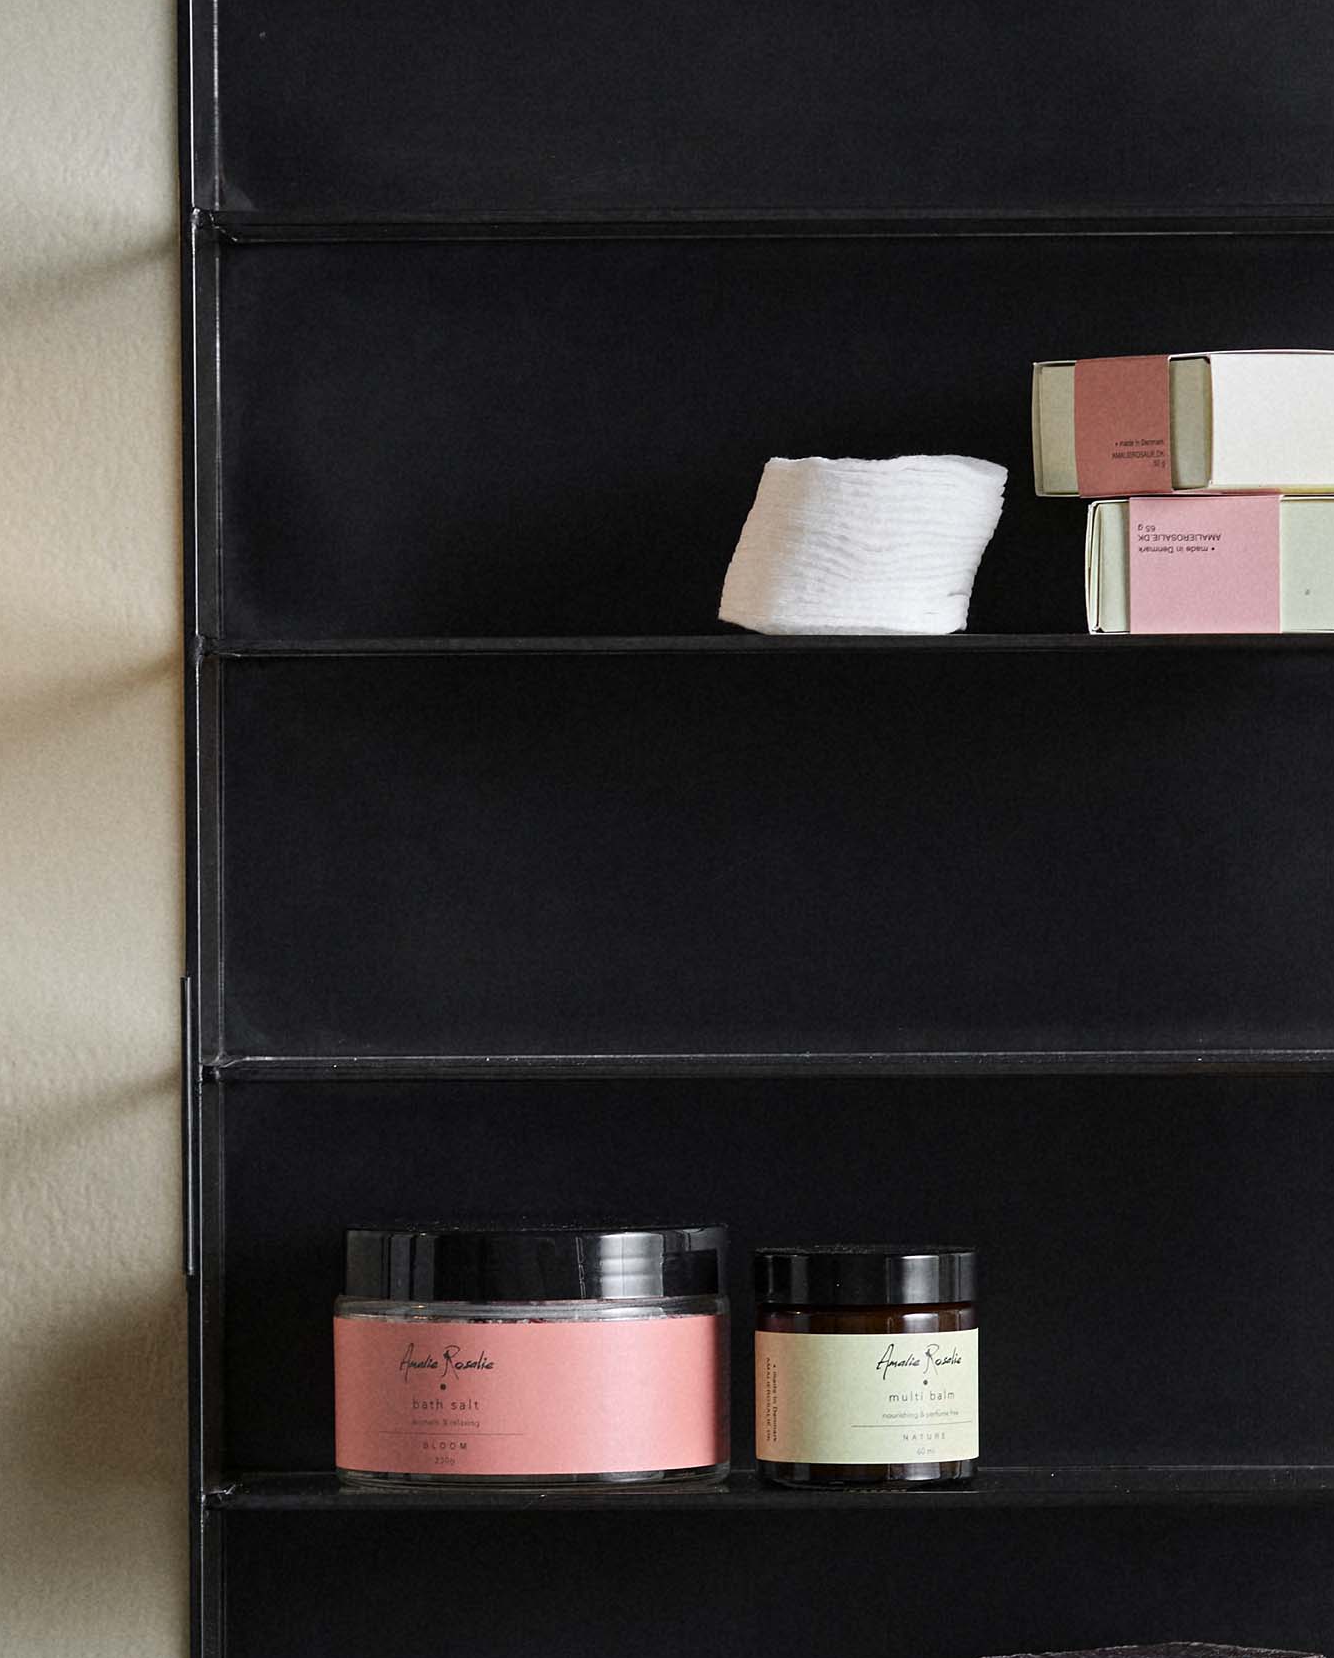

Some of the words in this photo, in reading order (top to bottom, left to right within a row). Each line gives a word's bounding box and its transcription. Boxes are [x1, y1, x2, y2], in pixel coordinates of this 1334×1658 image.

[1137, 523, 1144, 532] g
[1145, 525, 1156, 533] 65
[1138, 545, 1174, 554] Denmark
[440, 1345, 494, 1380] Rosalie
[875, 1343, 921, 1381] Amalie
[922, 1343, 962, 1376] Rosalie
[889, 1390, 924, 1403] multi
[929, 1390, 955, 1401] balm
[412, 1398, 444, 1410] bath
[450, 1398, 479, 1411] salt
[902, 1432, 946, 1441] NATURE
[422, 1441, 468, 1451] BLOOM
